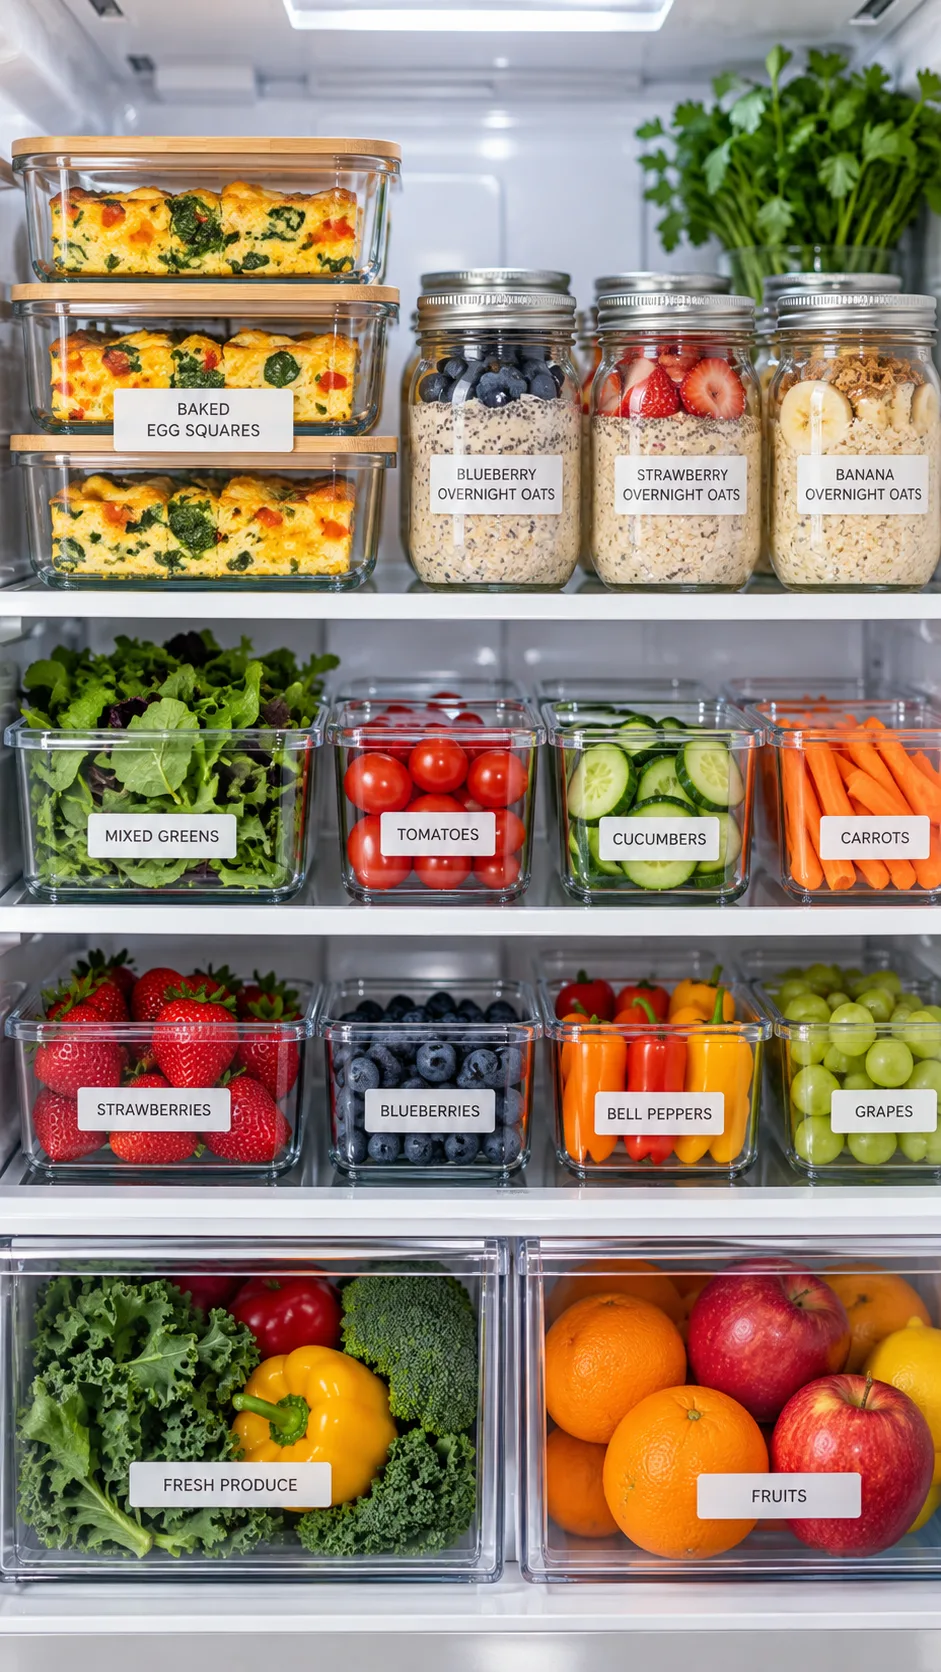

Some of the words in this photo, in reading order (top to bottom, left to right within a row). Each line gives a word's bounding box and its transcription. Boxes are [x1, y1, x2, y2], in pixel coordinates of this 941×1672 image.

[177, 402, 230, 416] BAKED
[147, 423, 180, 439] EGG
[185, 423, 260, 439] SQUARES
[456, 468, 537, 482] BLUEBERRY
[637, 468, 729, 482] STRAWBERRY
[836, 468, 895, 482] BANANA
[437, 487, 517, 501] OVERNIGHT
[521, 487, 555, 501] OATS
[623, 487, 704, 501] OVERNIGHT
[707, 487, 740, 501] OATS
[805, 487, 886, 501] OVERNIGHT
[889, 487, 922, 501] OATS
[105, 829, 153, 843] MIXED
[157, 829, 220, 843] GREENS
[396, 827, 479, 841] TOMATOES
[612, 832, 707, 846] CUCUMBERS
[841, 831, 910, 845] CARROTS
[97, 1103, 212, 1117] STRAWBERRIES
[380, 1104, 481, 1118] BLUEBERRIES
[607, 1107, 643, 1121] BELL
[647, 1107, 712, 1121] PEPPERS
[855, 1105, 913, 1119] GRAPES
[163, 1478, 214, 1492] FRESH
[220, 1478, 298, 1492] PRODUCE
[752, 1489, 807, 1503] FRUITS
